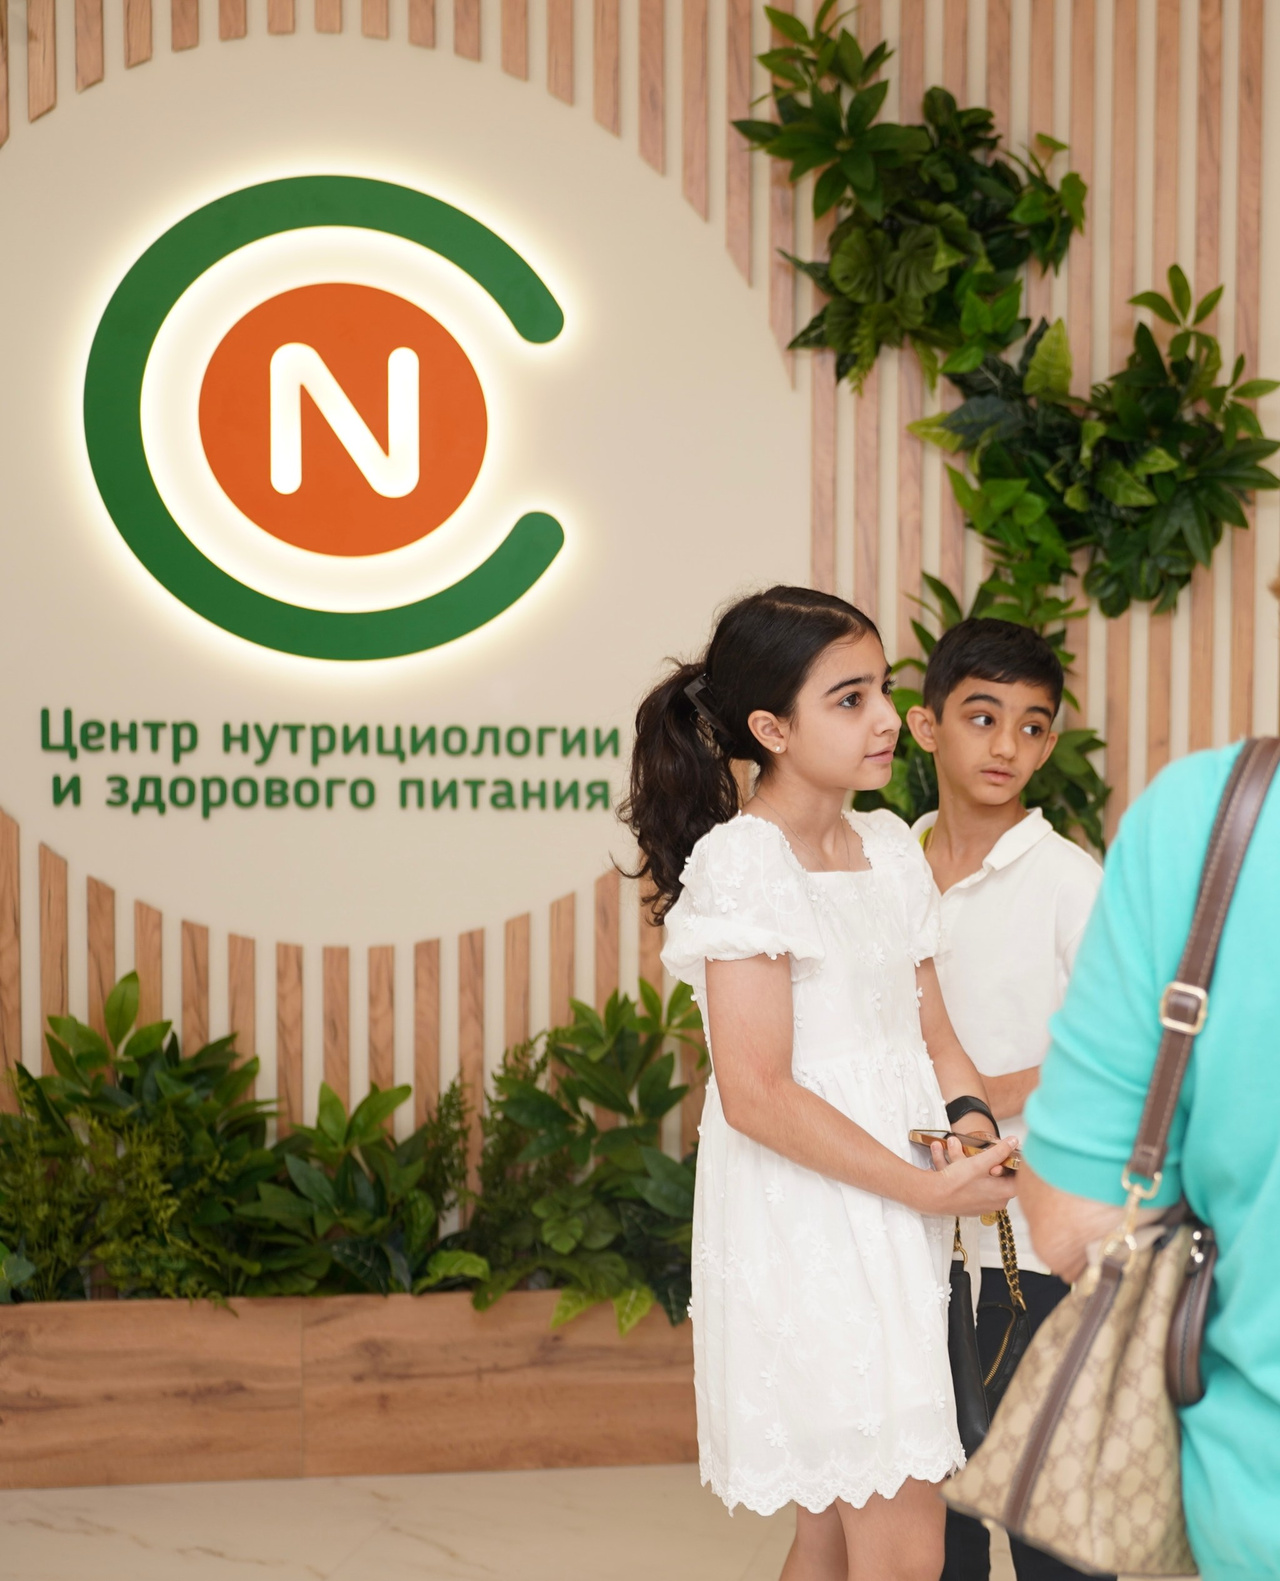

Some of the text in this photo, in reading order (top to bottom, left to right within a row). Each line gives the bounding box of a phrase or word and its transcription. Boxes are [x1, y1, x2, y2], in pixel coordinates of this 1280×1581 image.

[269, 341, 421, 499] N
[40, 707, 621, 767] Центр нутрициологии
[51, 774, 611, 819] и здорового питания
